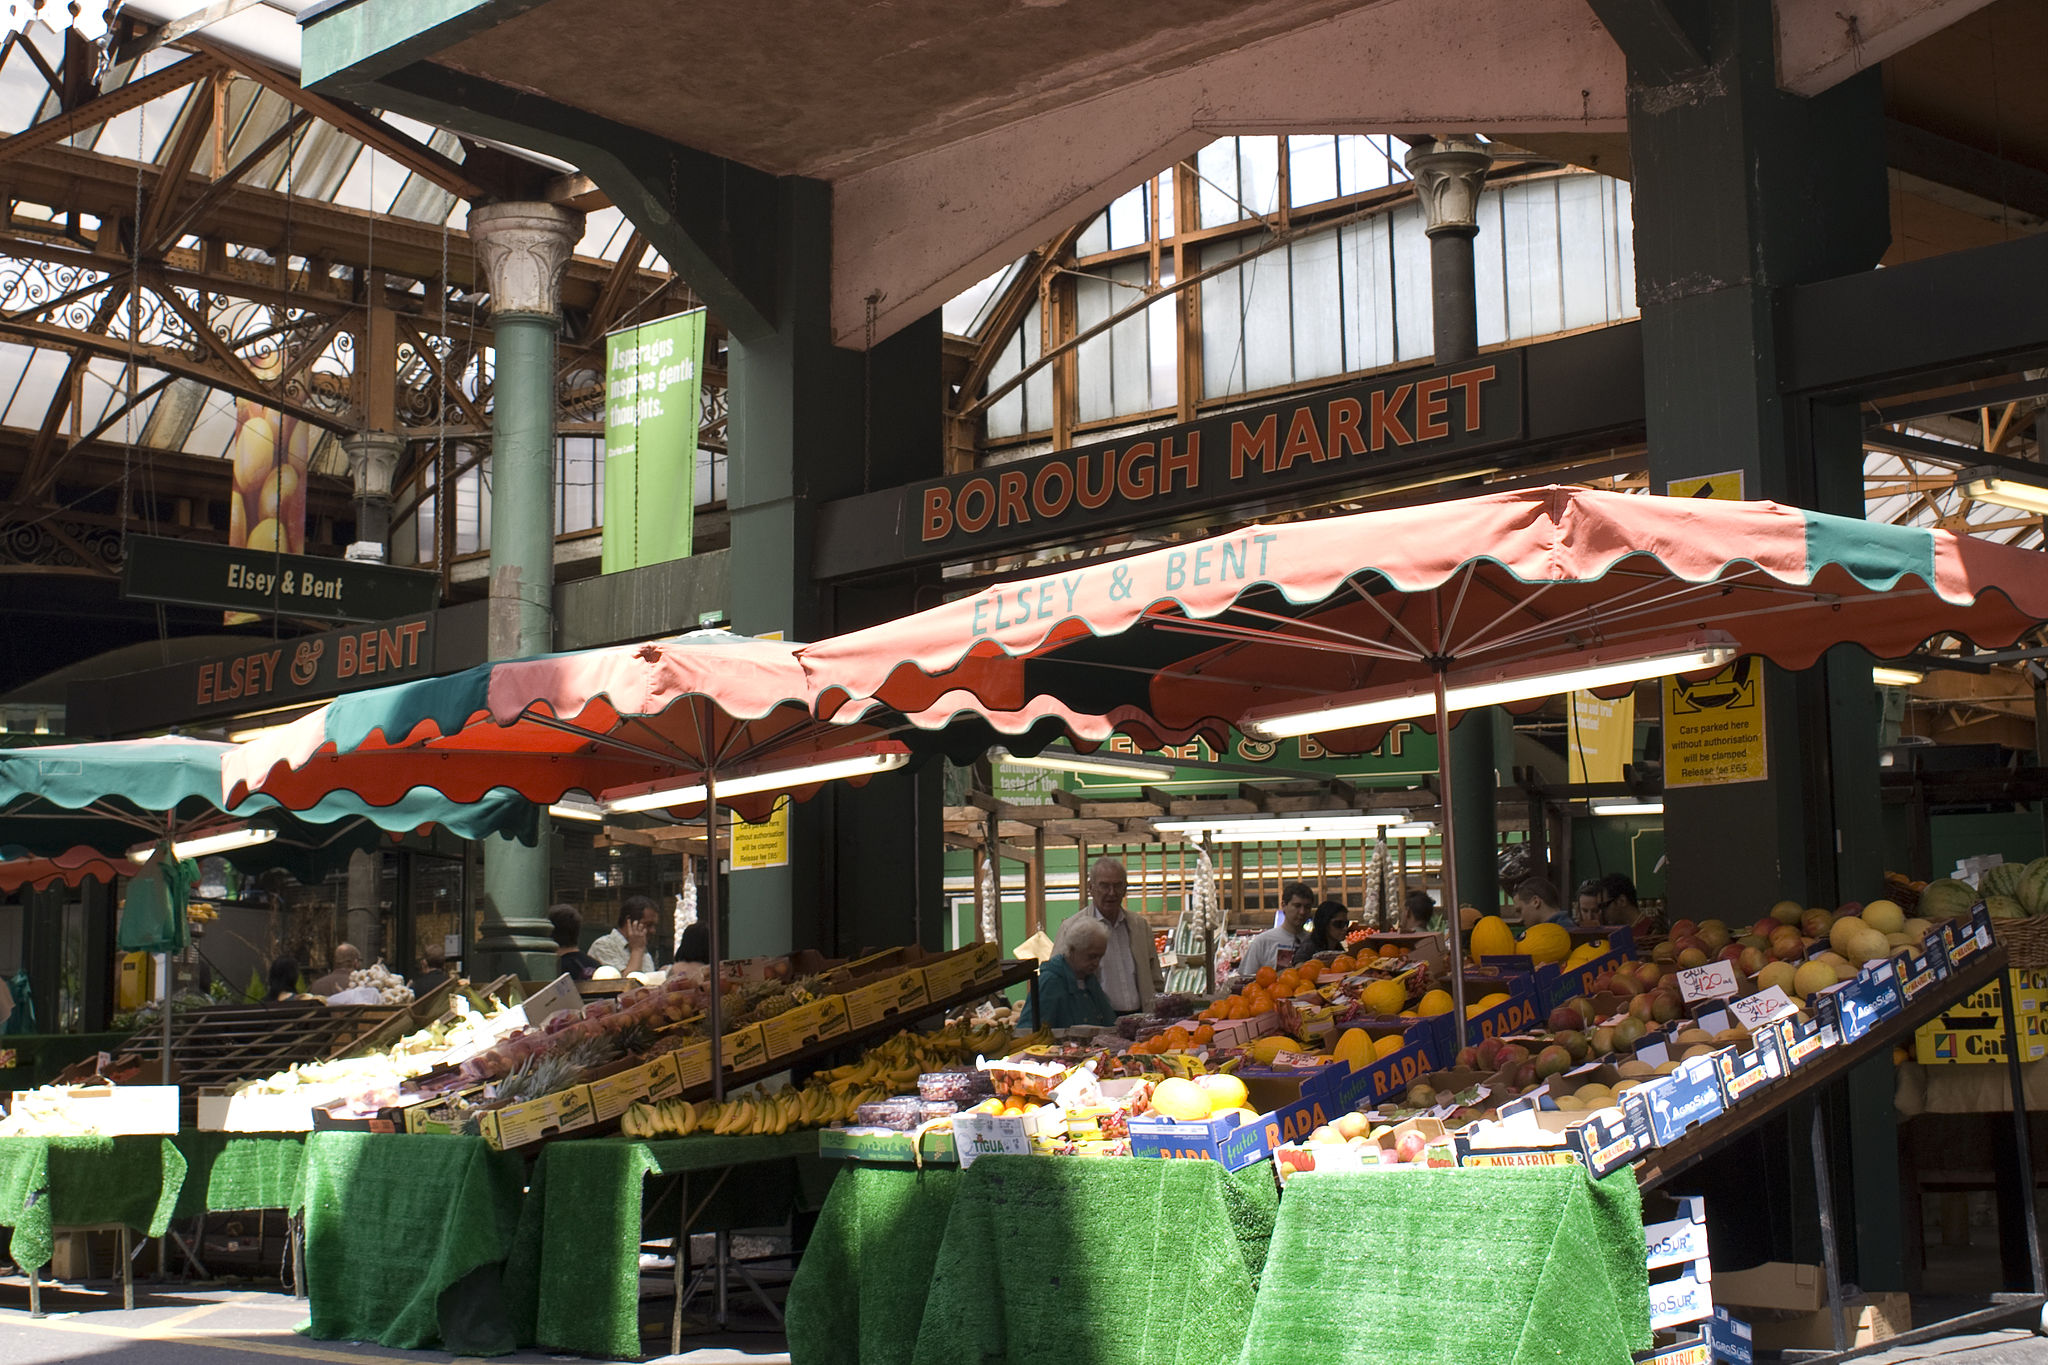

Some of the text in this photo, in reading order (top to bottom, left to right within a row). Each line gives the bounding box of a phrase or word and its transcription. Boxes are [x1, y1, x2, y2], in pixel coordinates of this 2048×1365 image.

[611, 338, 674, 373] Asparagus
[611, 370, 656, 400] inspires
[922, 365, 1496, 542] BOROUGH MARKET
[227, 563, 343, 600] Elsey & Bent
[971, 534, 1277, 637] ELSEY & BENT
[197, 621, 426, 705] ELSEY & BENT
[1110, 735, 1219, 762] EEY
[1299, 723, 1410, 758] BT
[1672, 734, 1758, 750] without authorisation
[1680, 720, 1749, 735] Cars parked here
[1681, 767, 1714, 777] Release
[1683, 749, 1747, 763] will be clamped
[1000, 776, 1058, 791] taste of the
[1481, 999, 1536, 1040] RADA
[1373, 1048, 1432, 1097] RADA
[973, 1139, 1004, 1153] TIGUA
[1226, 1129, 1259, 1165] frutas
[1265, 1102, 1329, 1150] RADA
[1491, 1154, 1556, 1167] MIRAFRUT
